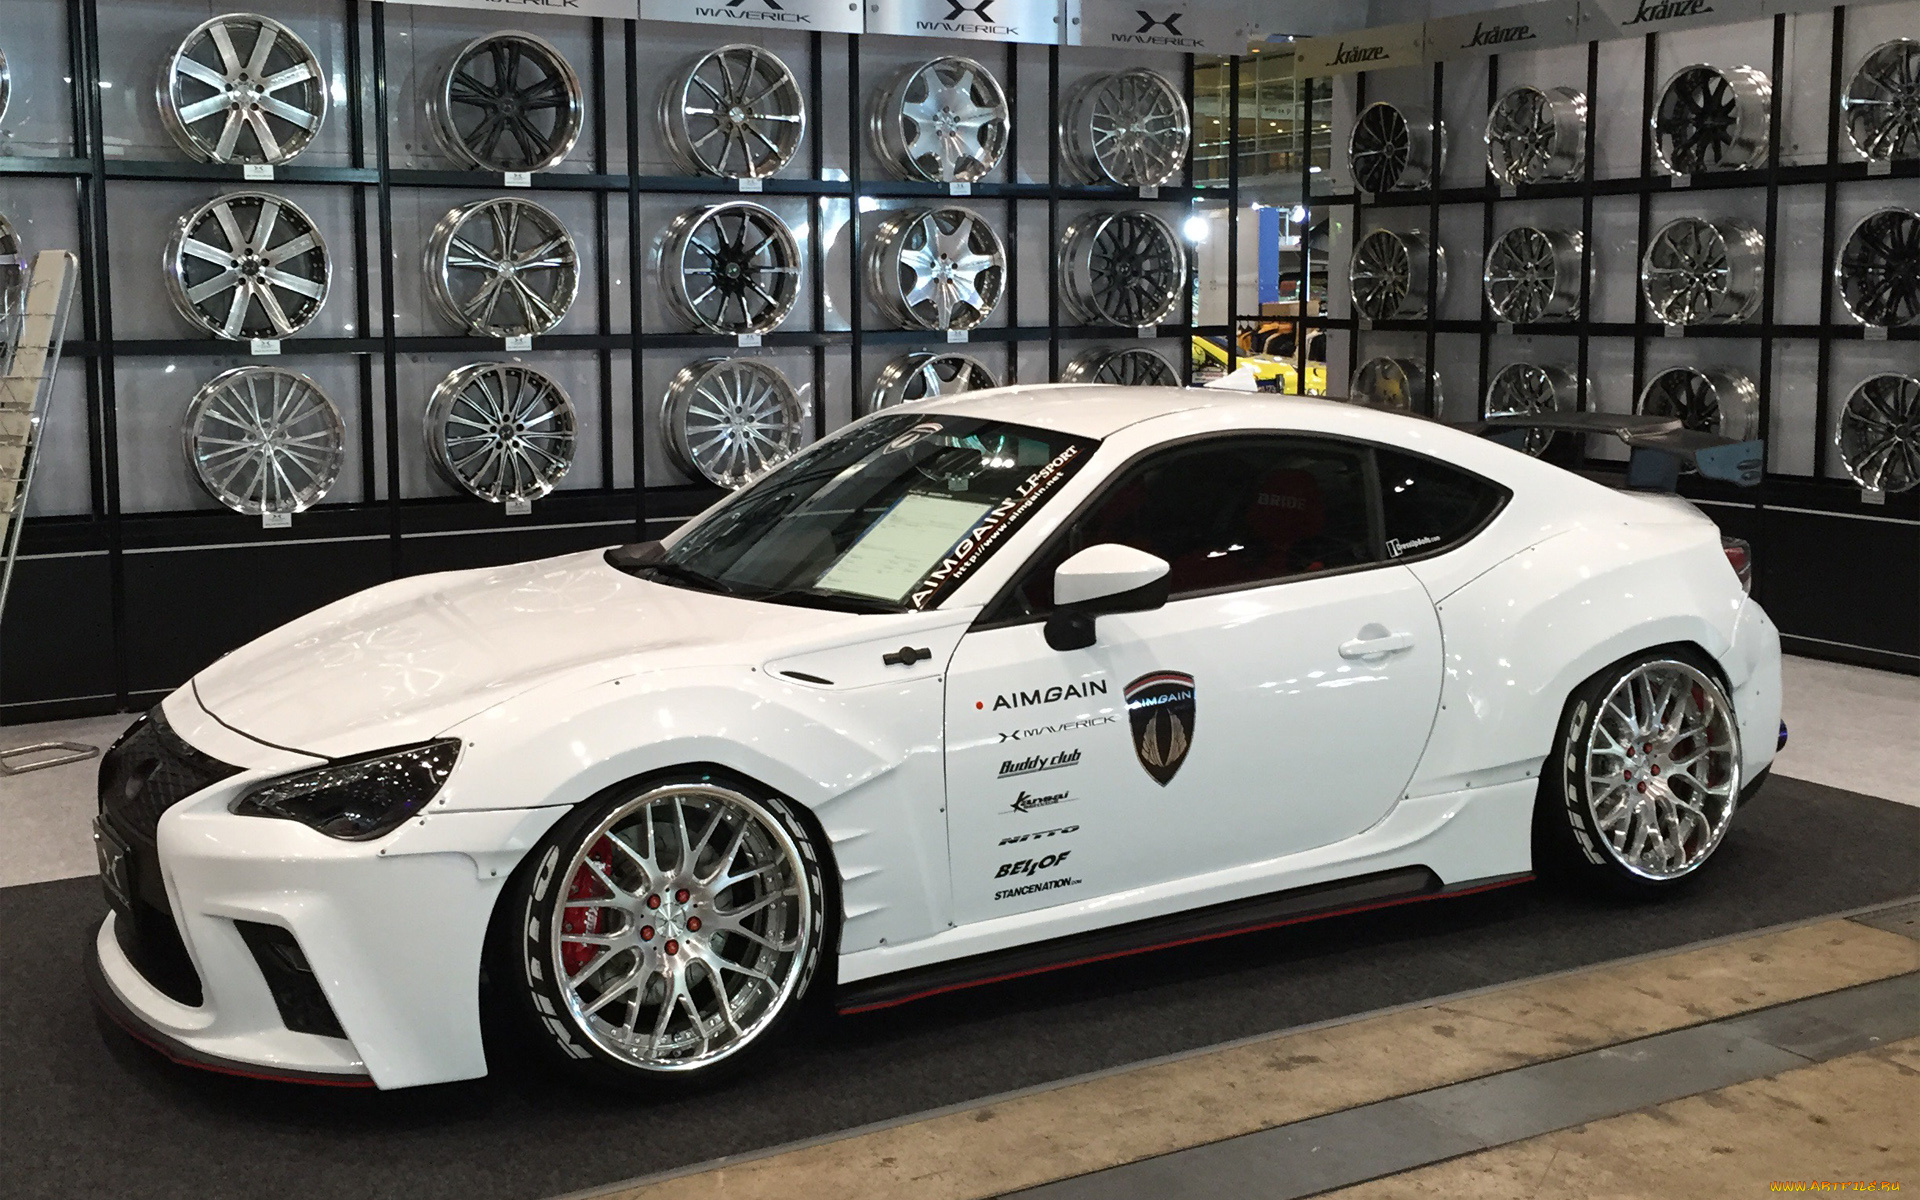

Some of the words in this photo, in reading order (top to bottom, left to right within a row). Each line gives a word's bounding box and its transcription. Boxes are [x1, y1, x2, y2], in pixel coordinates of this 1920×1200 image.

[696, 7, 811, 23] MAVERICK
[917, 21, 1019, 35] MAVERICK
[1111, 33, 1205, 47] MAVERICK
[1460, 22, 1537, 48] kränze
[1325, 42, 1390, 67] kränze
[953, 471, 1065, 579] http://www.aimgain.net
[992, 679, 1108, 711] AIMGAIN
[1024, 716, 1116, 738] MAVERICK
[998, 755, 1049, 775] Buddy
[1050, 748, 1082, 766] club
[998, 824, 1080, 847] NITTO
